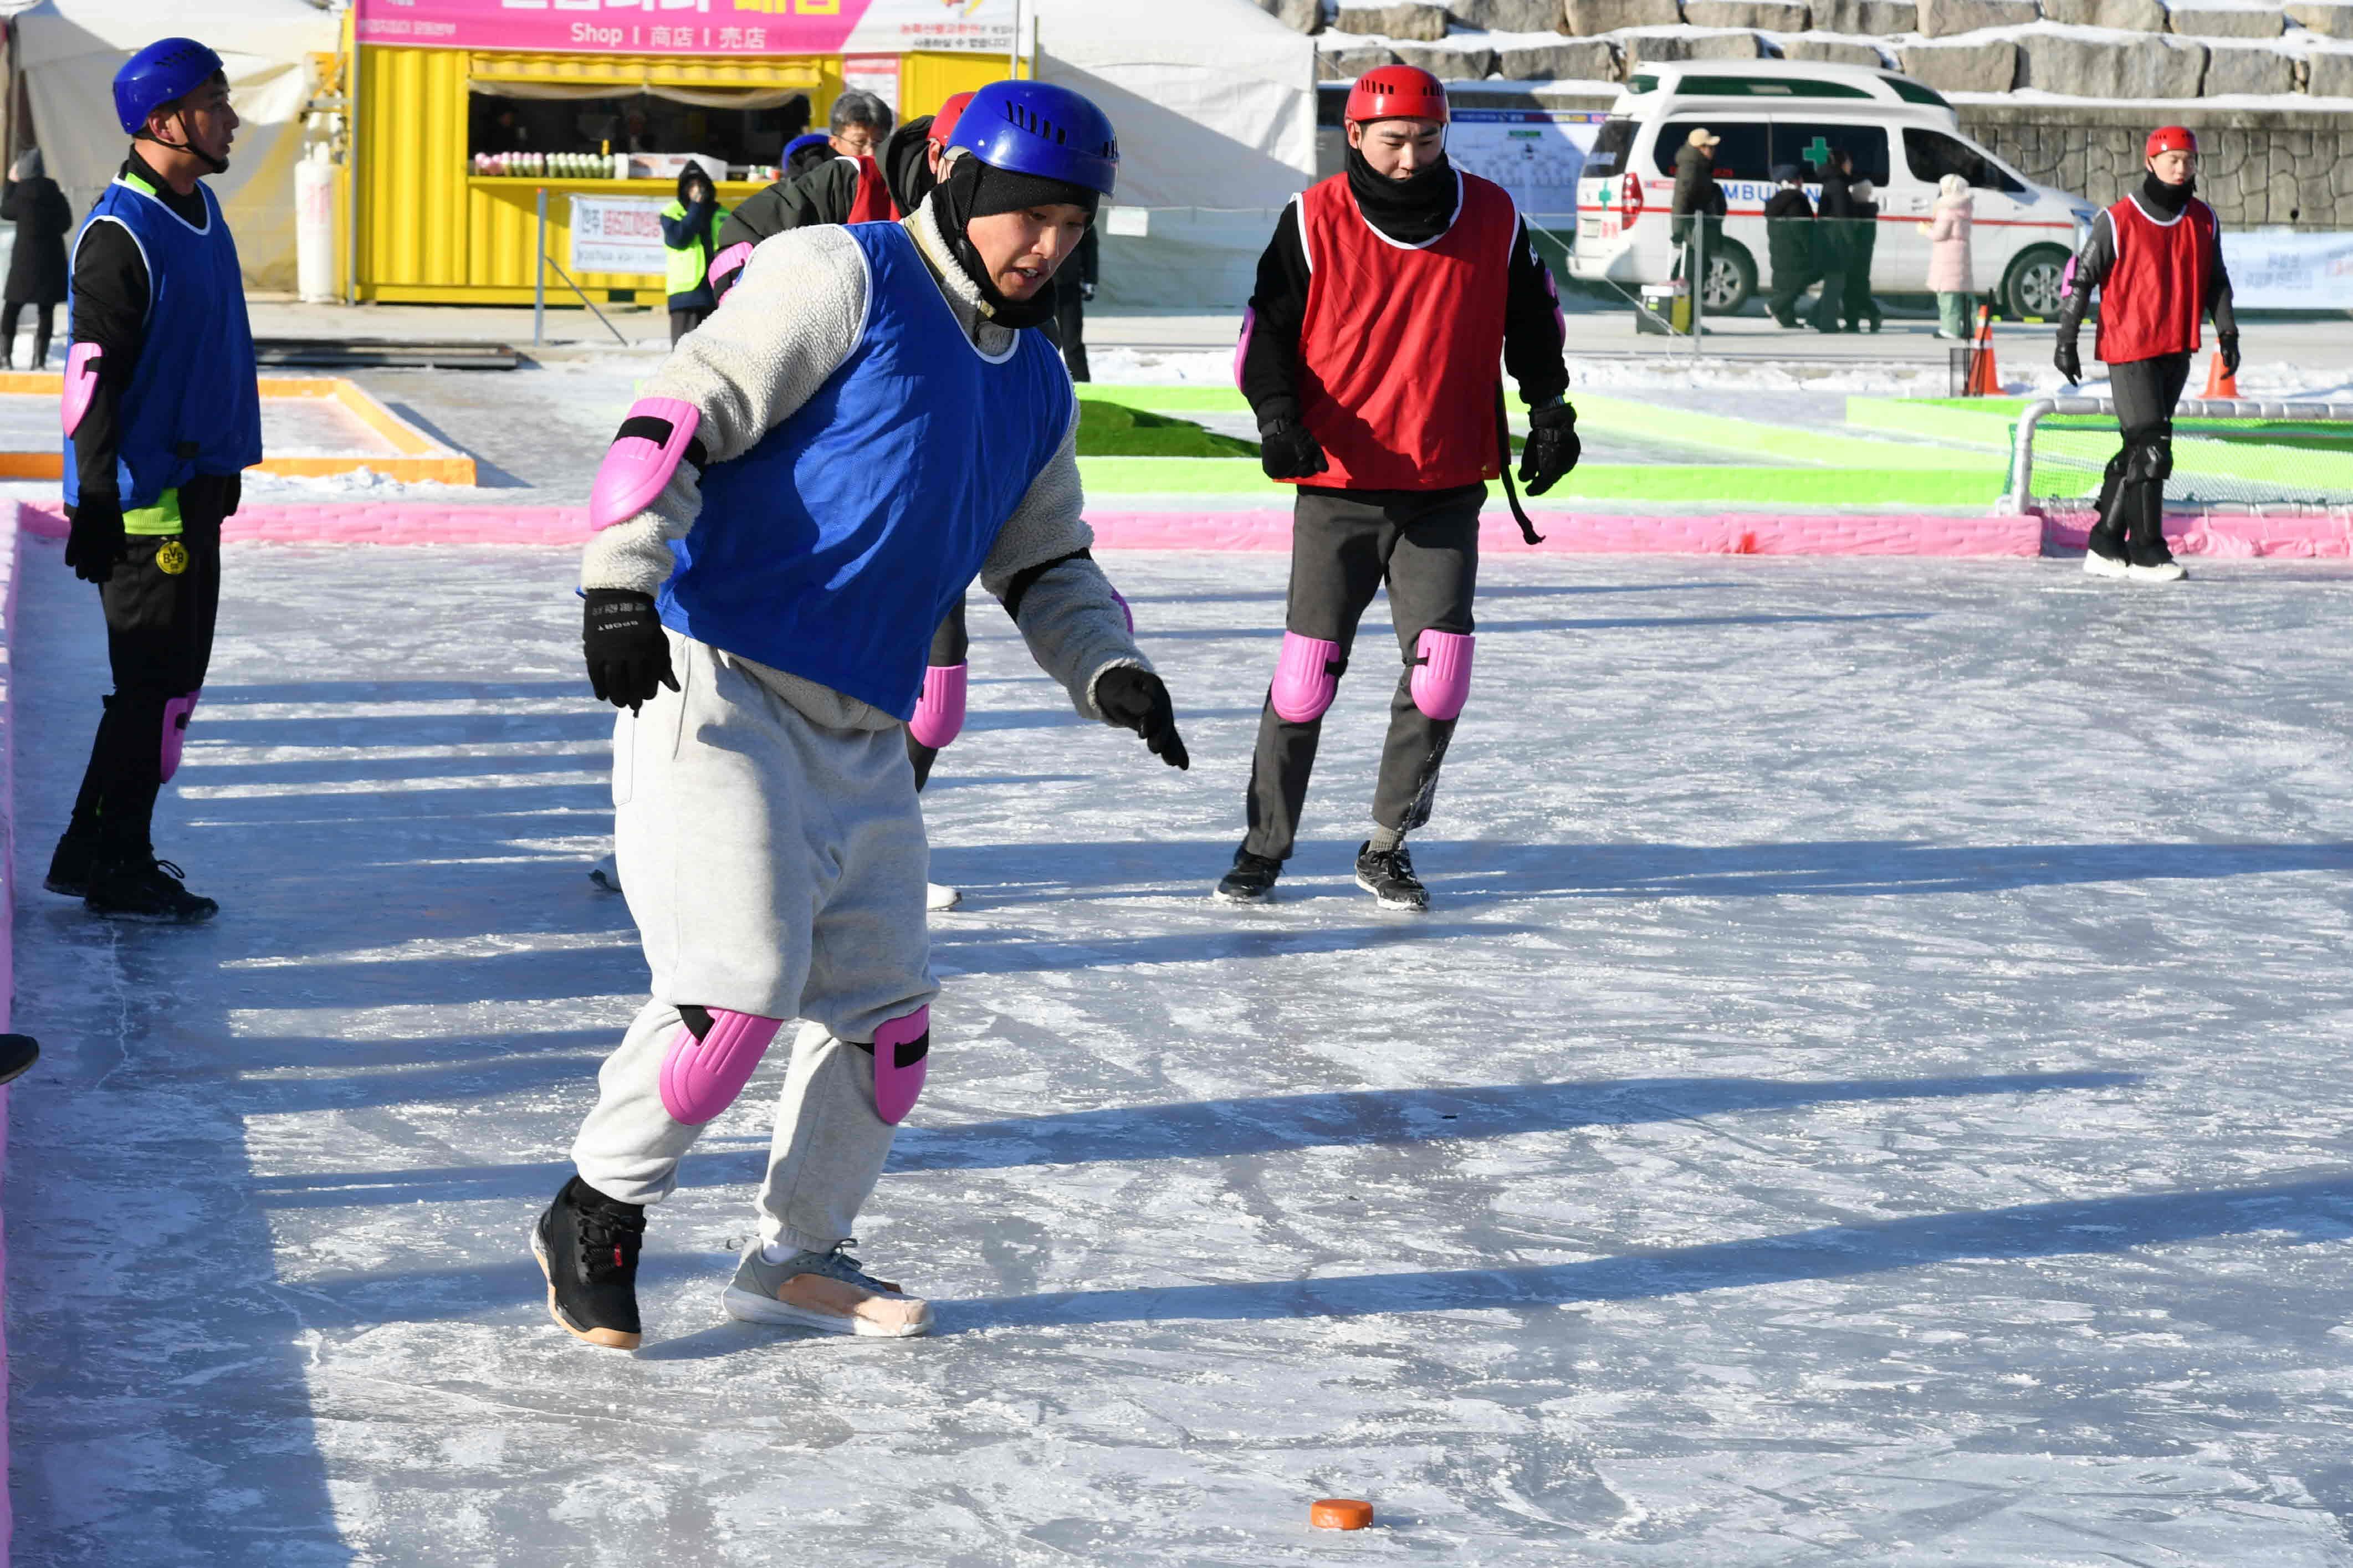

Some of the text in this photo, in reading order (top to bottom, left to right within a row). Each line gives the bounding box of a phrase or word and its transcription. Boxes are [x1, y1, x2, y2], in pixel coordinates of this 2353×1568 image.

[570, 22, 766, 50] Shop 商店 売店
